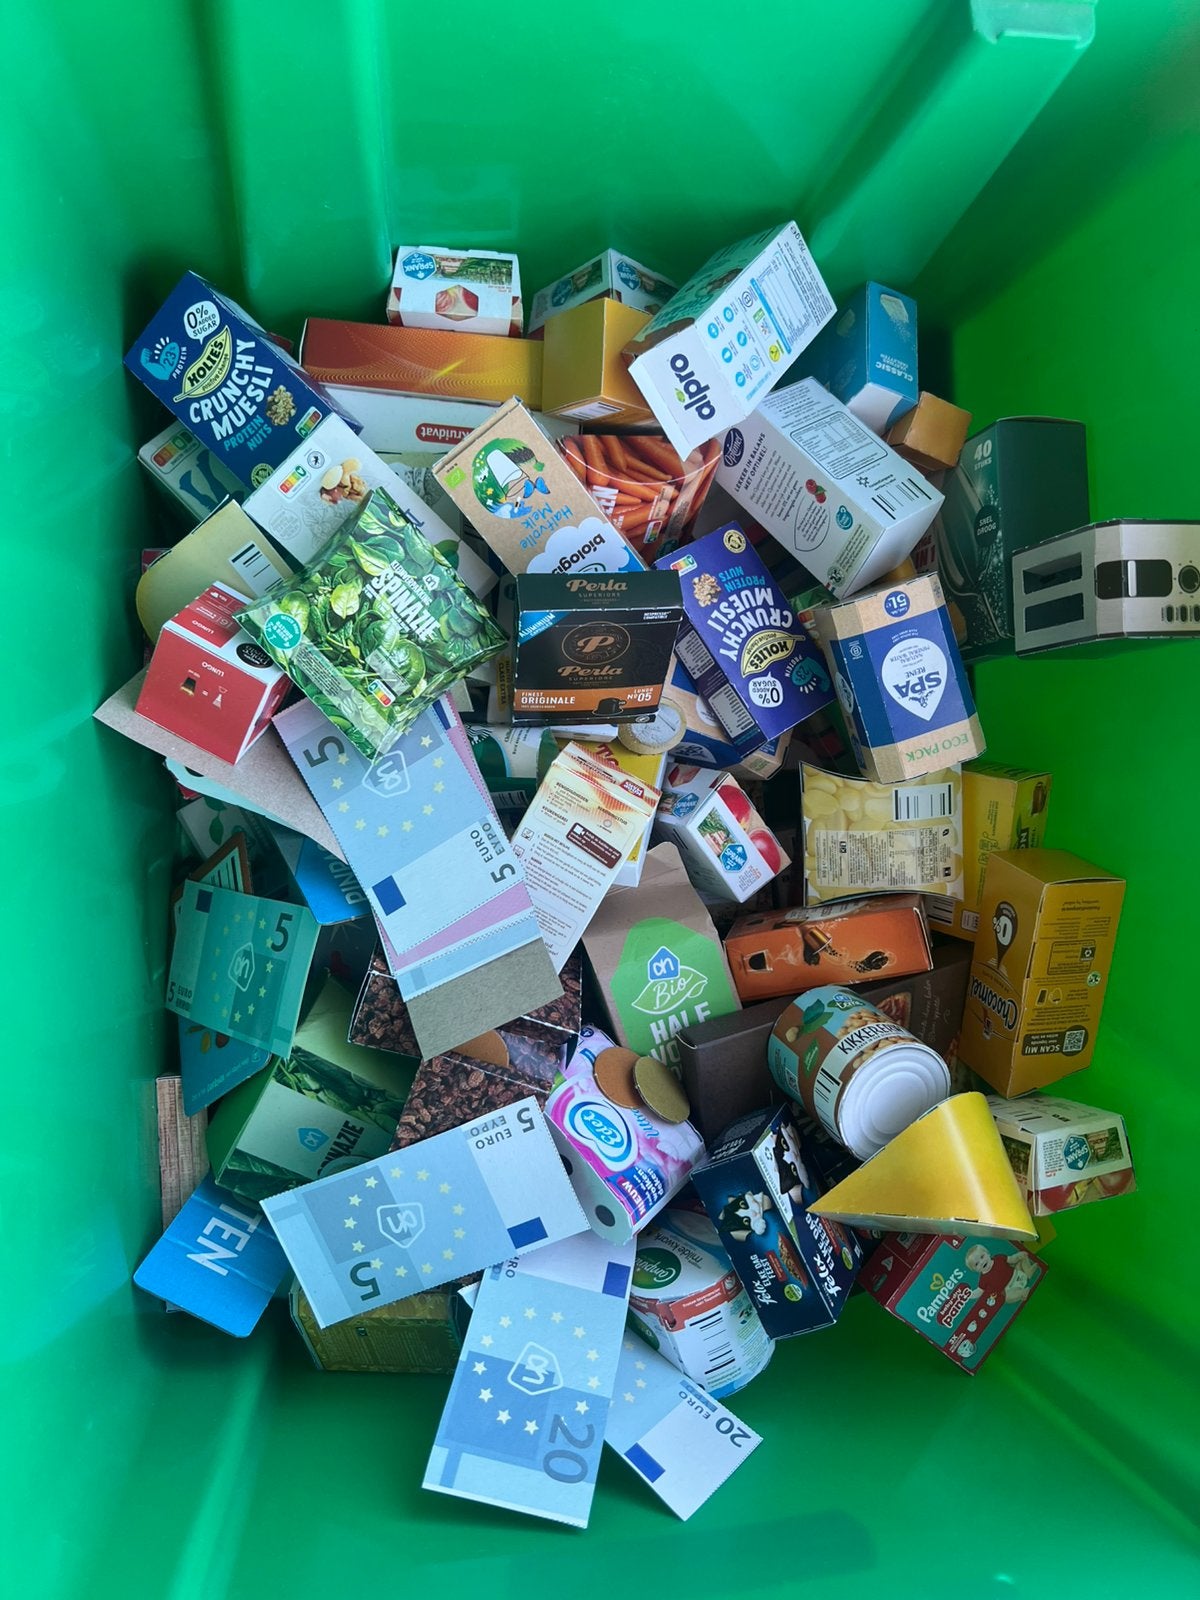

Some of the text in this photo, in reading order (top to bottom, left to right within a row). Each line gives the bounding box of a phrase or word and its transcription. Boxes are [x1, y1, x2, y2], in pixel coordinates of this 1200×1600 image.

[402, 262, 434, 272] SPRANK
[187, 305, 209, 329] 0%
[192, 321, 217, 337] SUGAR
[199, 314, 217, 326] ADDED
[172, 346, 187, 379] PROTEIN
[875, 361, 913, 381] CLASSIC
[189, 338, 256, 424] CRUNCHY
[669, 353, 716, 420] alpro
[211, 366, 273, 441] MUESLI
[223, 415, 264, 451] PROTEIN
[246, 425, 272, 451] NUTS
[735, 433, 765, 492] LEKKER IN BALANS
[973, 439, 992, 461] 40
[744, 446, 767, 490] MET OPTIMEL!
[973, 457, 992, 471] STUKS
[520, 505, 573, 550] Halfvolle
[521, 502, 553, 529] Melk
[978, 516, 993, 528] SNEL
[976, 522, 997, 537] DROOG
[566, 579, 628, 592] Perla
[718, 566, 744, 582] NUTS
[725, 575, 766, 592] PROTEIN
[371, 568, 441, 642] SPINAZIE
[706, 588, 774, 633] MUESLI
[888, 594, 908, 609] 5L
[192, 620, 215, 635] LUNGO
[519, 613, 556, 638] ALUMINIUM
[719, 608, 793, 662] CRUNCHY
[201, 661, 225, 677] LUNGO
[558, 665, 624, 677] Perla
[785, 655, 803, 678] PROTEIN
[905, 667, 926, 676] REINE
[752, 680, 777, 688] SUGAR
[758, 687, 780, 704] 0%
[893, 671, 943, 699] SPA
[303, 735, 345, 768] 5
[906, 732, 969, 762] ECO PACK
[470, 829, 493, 864] EURO
[490, 863, 516, 884] 5
[271, 912, 294, 952] 5
[167, 981, 176, 1002] 5
[177, 985, 192, 999] EURO
[653, 974, 693, 1010] Bio
[970, 976, 1019, 1031] Chocomel
[837, 1022, 908, 1055] KIKKERER
[1024, 1044, 1060, 1054] SCAN MIJ
[516, 1107, 535, 1133] 5
[583, 1111, 623, 1147] Edet
[475, 1129, 513, 1150] EURO
[1067, 1143, 1089, 1163] SPRANK
[645, 1168, 666, 1194] deken
[621, 1180, 646, 1215] NIEUW
[804, 1212, 835, 1270] ELKE DAG
[813, 1216, 834, 1253] FEEST
[750, 1253, 770, 1287] ELKE DAG
[760, 1256, 775, 1279] FEEST
[350, 1261, 381, 1301] 5
[916, 1268, 964, 1323] Pampers
[939, 1288, 962, 1316] baby-dry
[942, 1287, 974, 1328] pants
[948, 1334, 958, 1345] 3X
[678, 1390, 712, 1420] EURO
[715, 1417, 752, 1449] 20
[542, 1414, 595, 1484] 20
